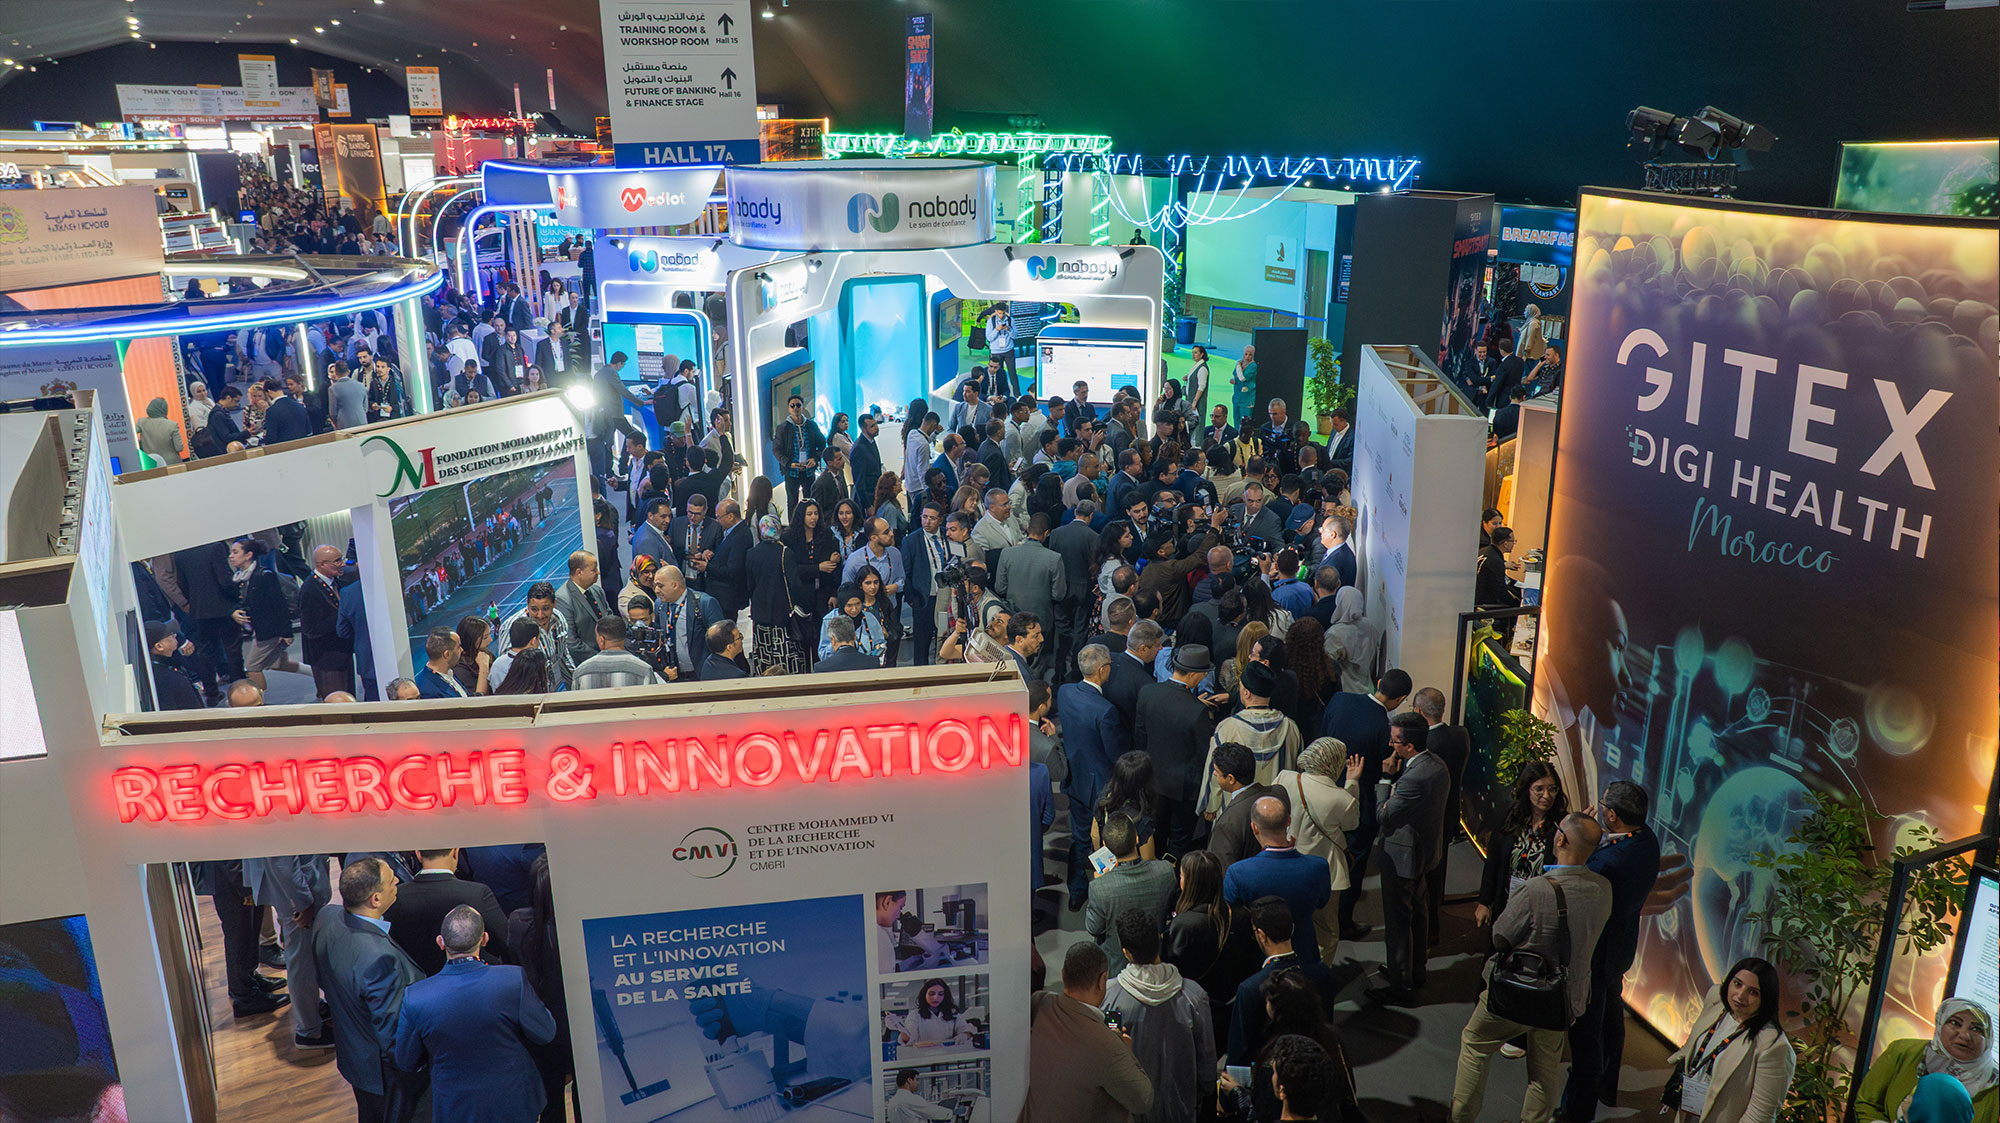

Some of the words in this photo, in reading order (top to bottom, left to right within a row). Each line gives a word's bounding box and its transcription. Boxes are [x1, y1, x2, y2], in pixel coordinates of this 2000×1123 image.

[618, 10, 645, 22] الورش
[653, 12, 685, 22] التدريب
[686, 12, 705, 22] غرف
[619, 26, 666, 34] TRAINING
[620, 38, 678, 46] WORKSHOP
[908, 35, 931, 49] SMART
[622, 62, 660, 72] مستقبل
[662, 61, 688, 71] منصة
[624, 75, 656, 85] التمويل
[664, 75, 692, 84] البنوك
[625, 87, 660, 95] FUTURE
[662, 87, 674, 95] OF
[676, 86, 717, 94] BANKING
[634, 99, 673, 107] FINANCE
[675, 98, 704, 106] STAGE
[644, 146, 701, 165] HALL
[704, 145, 734, 162] 17A
[735, 195, 781, 225] abady
[909, 194, 977, 220] nabady
[909, 221, 917, 229] Le
[918, 220, 931, 229] soin
[933, 220, 940, 228] de
[941, 219, 967, 228] confiance
[1502, 227, 1574, 247] BREAKFAS
[661, 252, 699, 266] nabad
[1616, 328, 1954, 491] GITEX
[436, 442, 500, 465] FONDATION
[500, 429, 562, 449] MOHAMMED
[562, 426, 574, 438] VI
[438, 466, 459, 479] DES
[460, 456, 510, 476] SCIENCES
[512, 451, 525, 461] ET
[526, 447, 540, 459] DE
[554, 433, 585, 453] SANTÉ
[1629, 426, 1713, 489] DIGI
[1730, 459, 1933, 559] HEALTH
[1688, 496, 1840, 573] Morocco
[111, 748, 527, 823] RECHERCHE
[546, 745, 597, 801] &
[611, 711, 1023, 797] INNOVATION
[747, 822, 796, 835] CENTRE
[798, 815, 878, 831] MOHAMMED
[880, 814, 895, 823] VI
[748, 836, 766, 847] DE
[768, 835, 784, 846] LA
[787, 829, 861, 844] RECHERCHE
[672, 842, 738, 861] CMVI
[749, 850, 764, 860] ET
[767, 848, 784, 858] DE
[786, 839, 876, 857] L'INNOVATION
[749, 860, 786, 872] CM6RI
[610, 934, 637, 949] LA
[642, 921, 768, 945] RECHERCHE
[613, 953, 637, 968] ET
[643, 939, 786, 965] L'INNOVATION
[614, 972, 645, 987] AU
[650, 963, 739, 984] SERVICE
[616, 991, 646, 1006] DE
[651, 988, 679, 1003] LA
[683, 977, 752, 1000] SANTÉ
